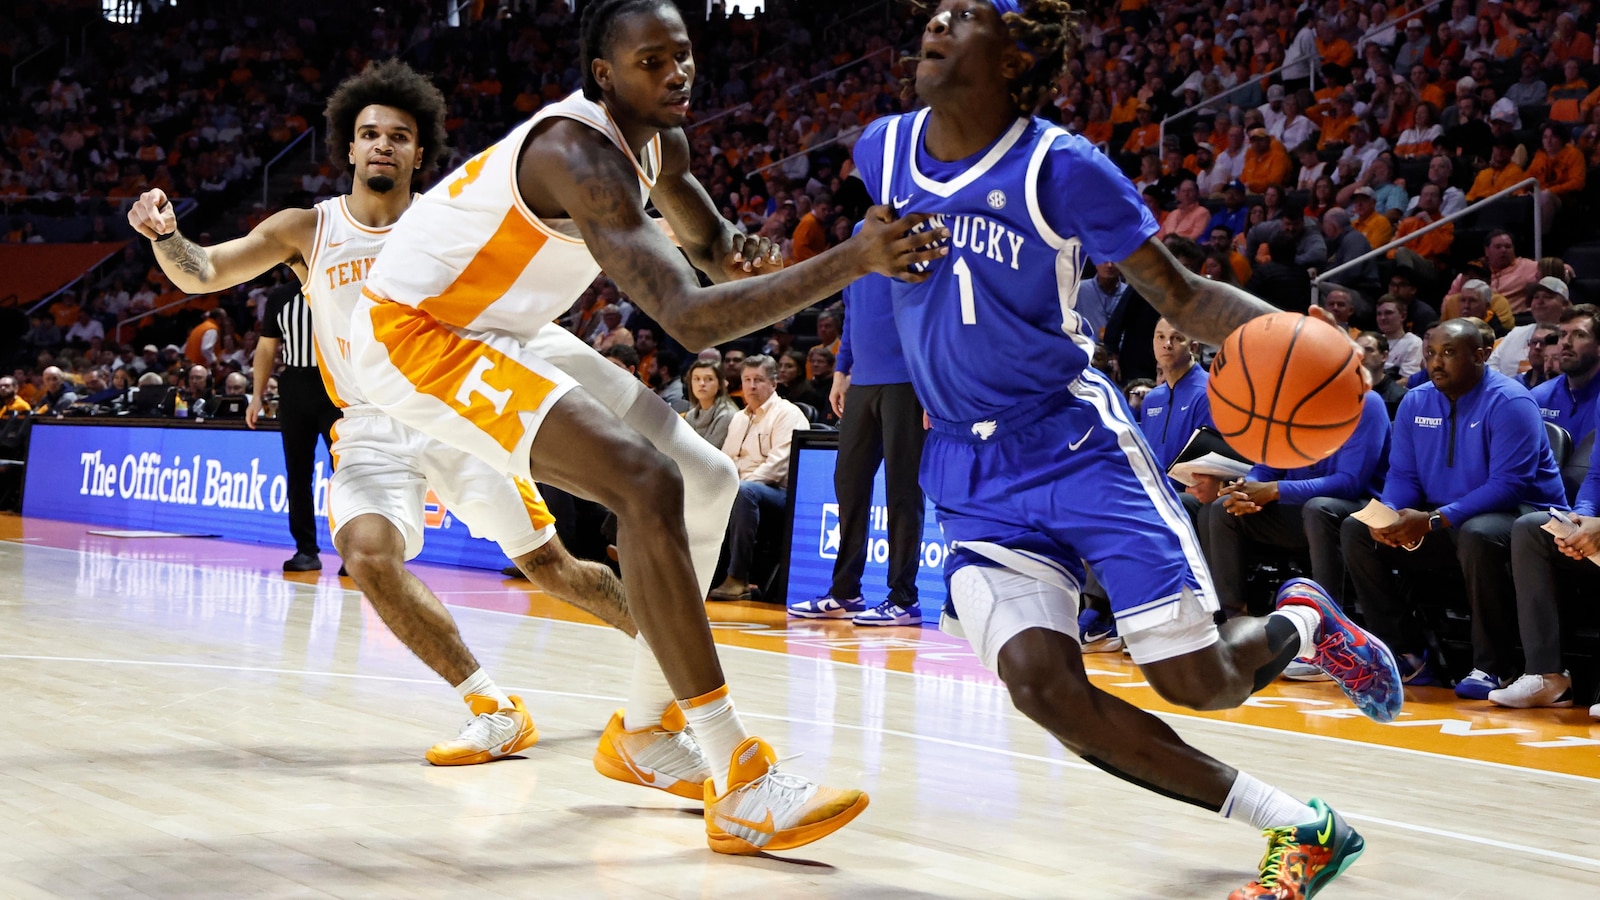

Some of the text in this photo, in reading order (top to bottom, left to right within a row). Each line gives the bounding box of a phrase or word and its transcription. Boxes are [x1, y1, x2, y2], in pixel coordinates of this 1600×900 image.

[952, 255, 977, 326] 1
[455, 355, 513, 415] T
[80, 450, 117, 497] The
[119, 452, 200, 505] Official
[202, 457, 267, 511] Bank
[269, 474, 289, 514] o
